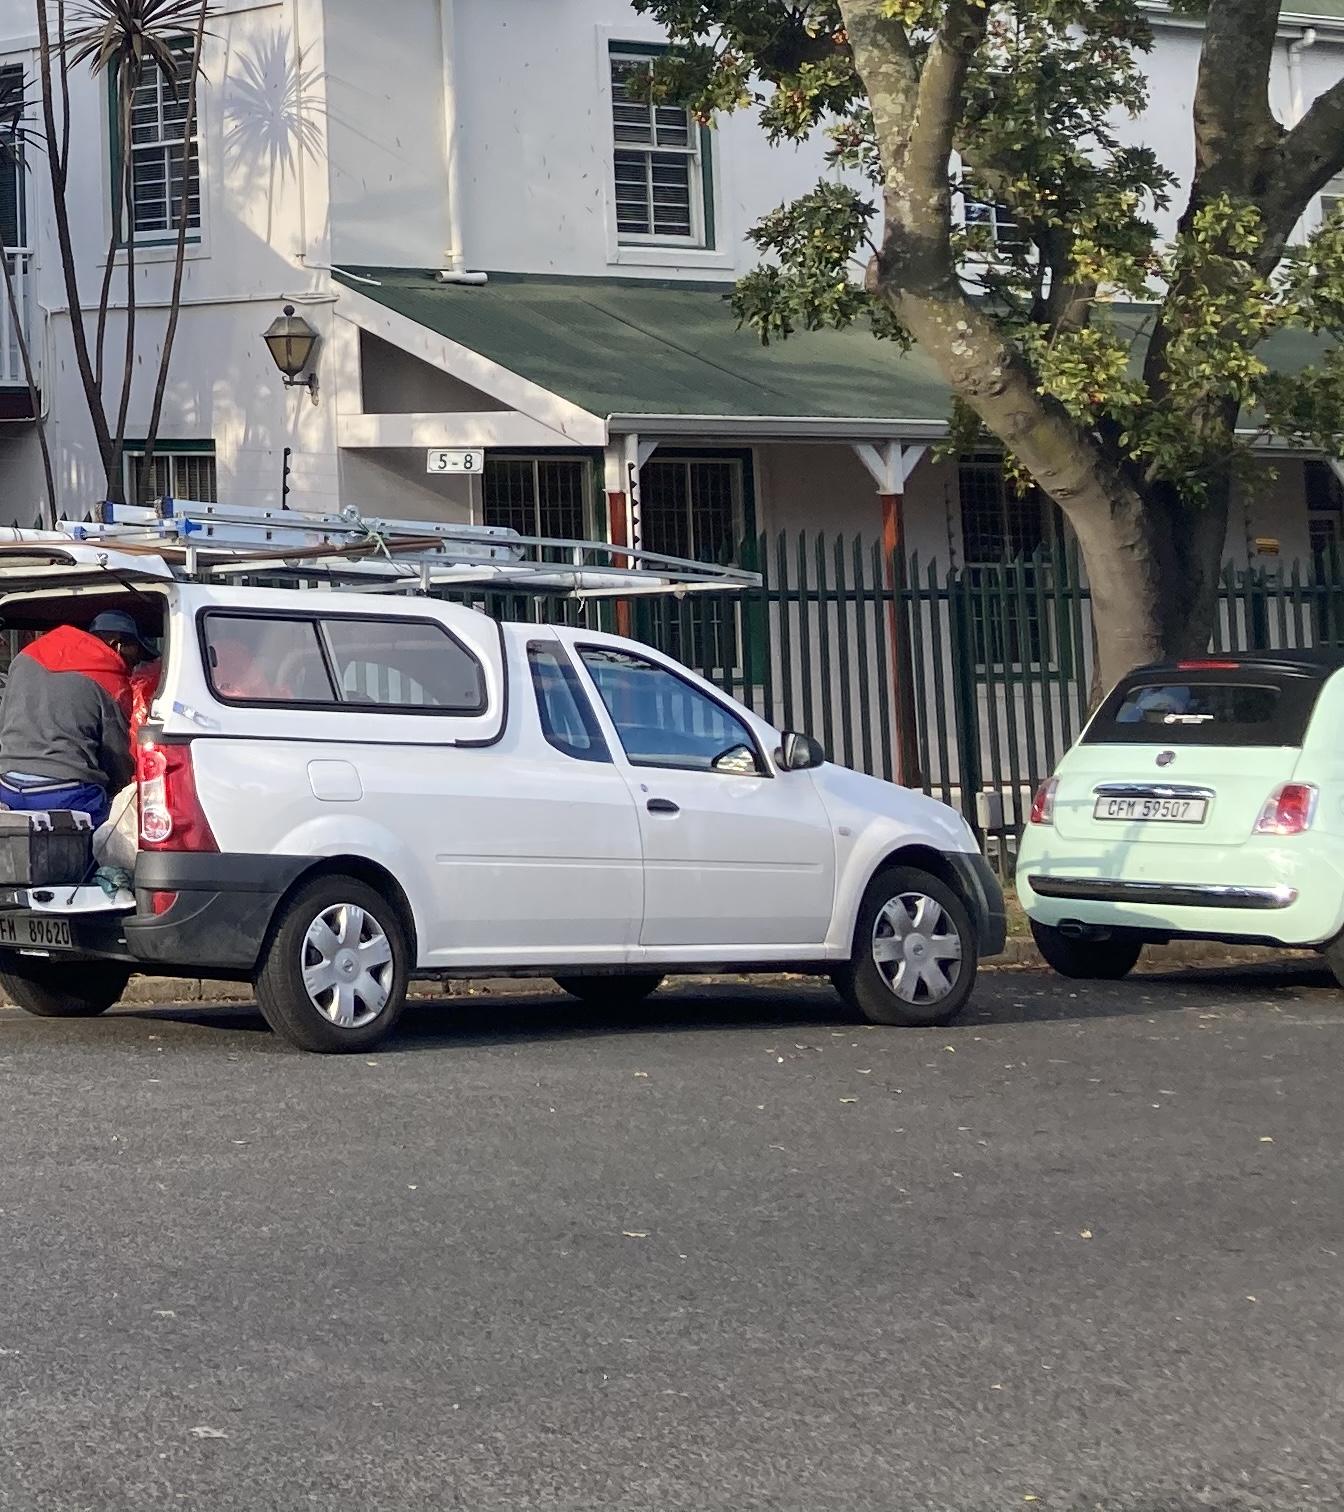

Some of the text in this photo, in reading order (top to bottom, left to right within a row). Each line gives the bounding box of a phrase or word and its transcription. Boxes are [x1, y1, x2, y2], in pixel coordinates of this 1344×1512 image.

[1108, 799, 1191, 819] CFM 59507
[28, 919, 70, 945] 89620
